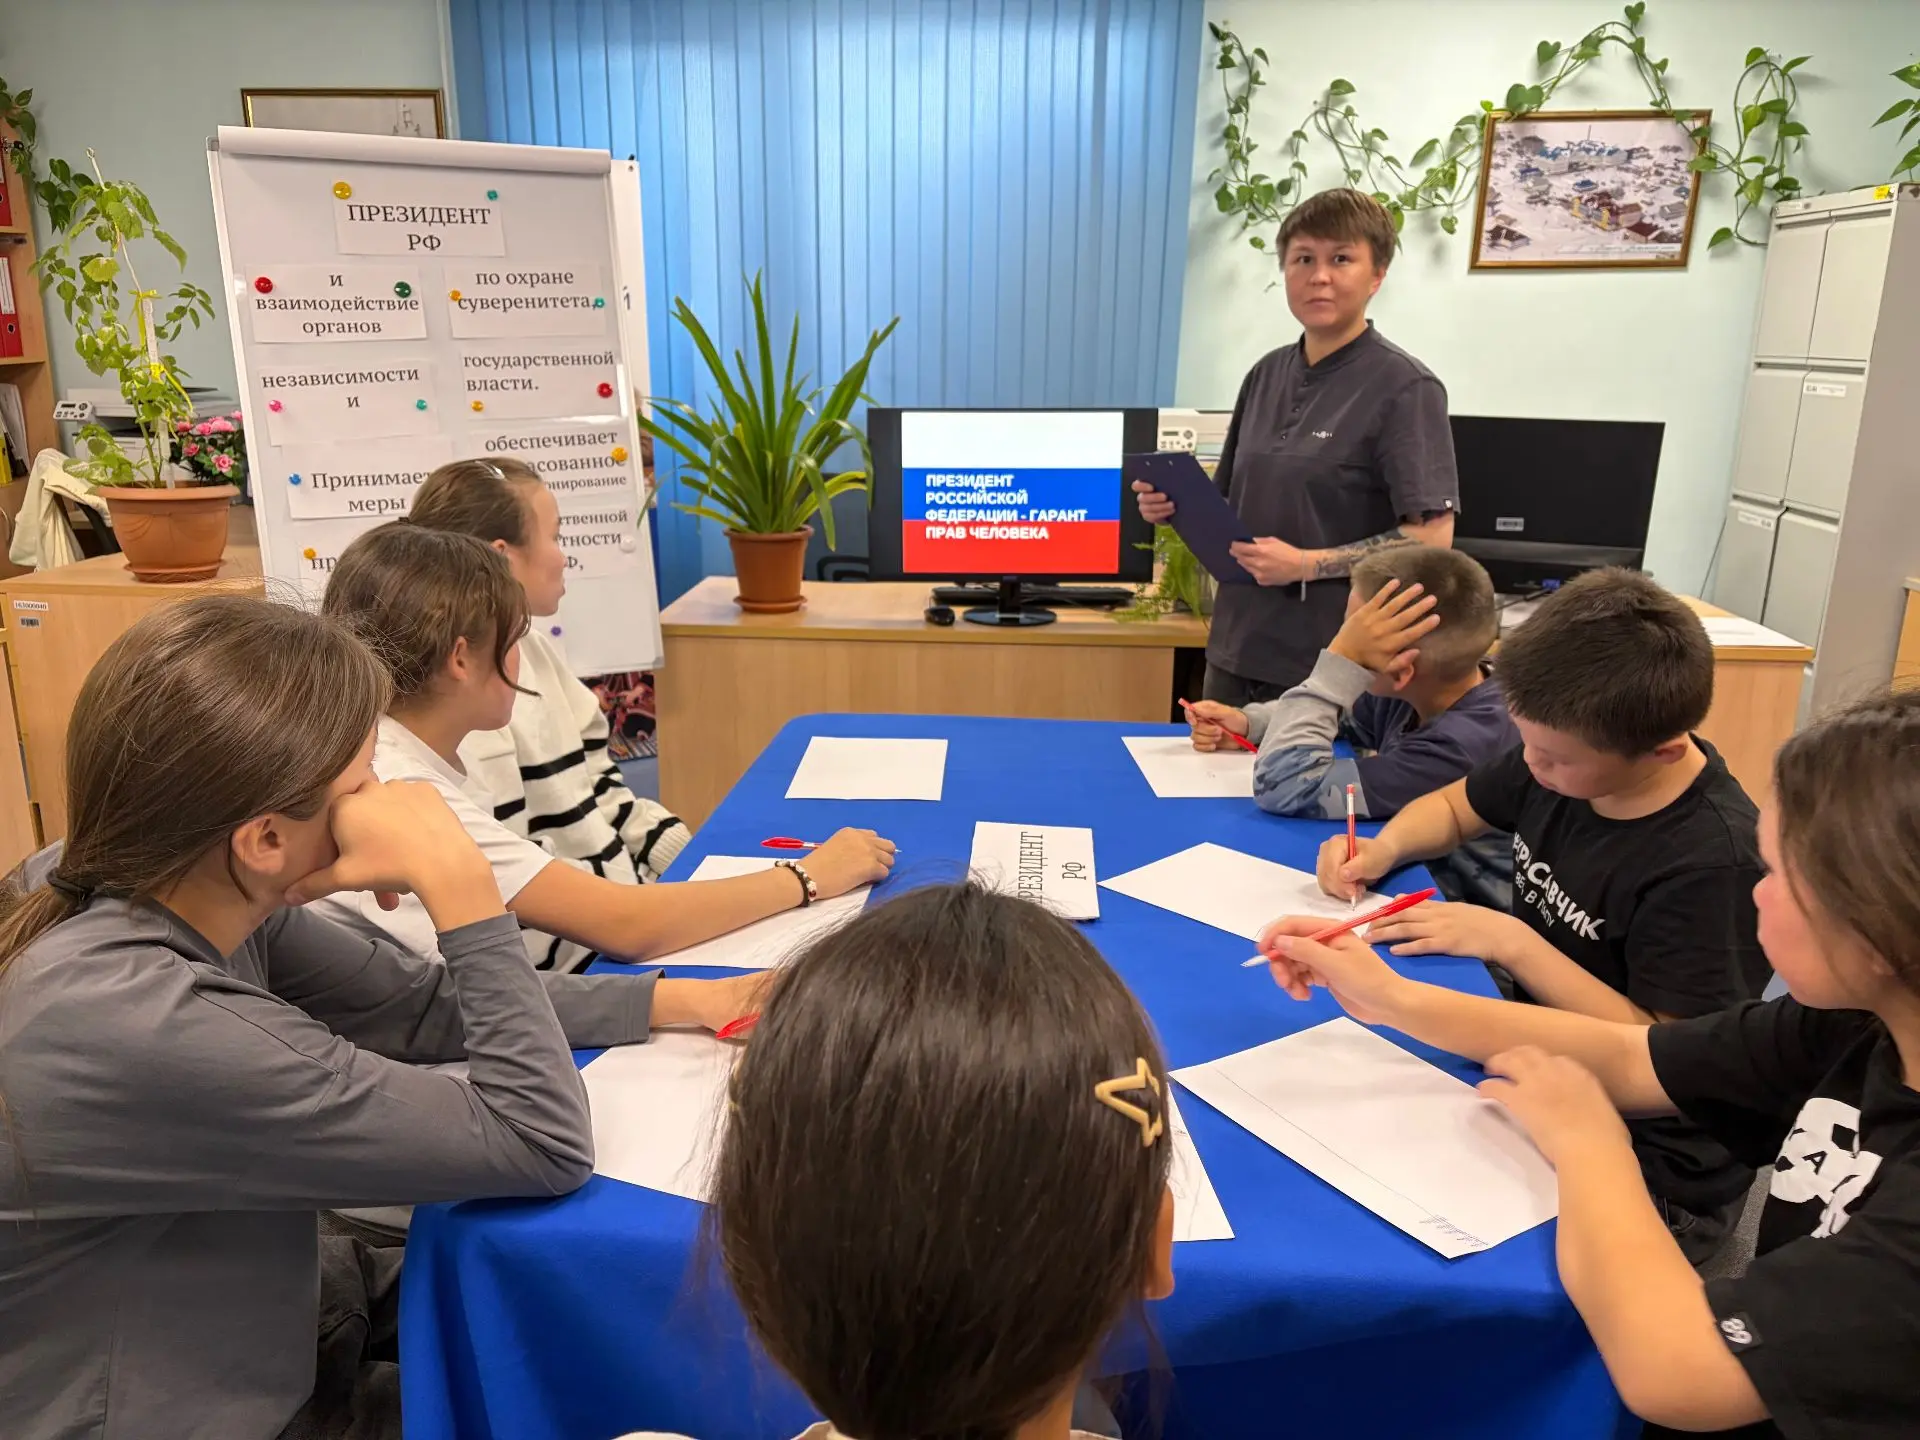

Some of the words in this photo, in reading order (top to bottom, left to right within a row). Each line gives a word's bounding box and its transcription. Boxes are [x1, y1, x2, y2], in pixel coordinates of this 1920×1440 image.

[347, 204, 491, 227] ПРЕЗИДЕНТ
[407, 234, 441, 251] РФ
[330, 274, 344, 287] и
[476, 272, 500, 285] по
[506, 271, 574, 288] охране
[255, 297, 419, 313] взаимодействие
[302, 321, 382, 336] органов
[464, 352, 614, 370] государственной
[262, 369, 420, 388] независимости
[466, 378, 539, 392] власти.
[347, 396, 361, 408] и
[485, 432, 618, 452] обеспечивает
[926, 474, 1014, 490] ПРЕЗИДЕНТ
[348, 497, 406, 513] меры
[926, 489, 1028, 505] РОССИЙСКОЙ
[925, 509, 1018, 523] ФЕДЕРАЦИИ
[1029, 509, 1088, 522] ГАРАНТ
[926, 527, 965, 540] ПРАВ
[970, 527, 1049, 540] ЧЕЛОВЕКА
[1017, 831, 1048, 904] РЕЗИДЕНТ
[1061, 861, 1087, 881] РФ
